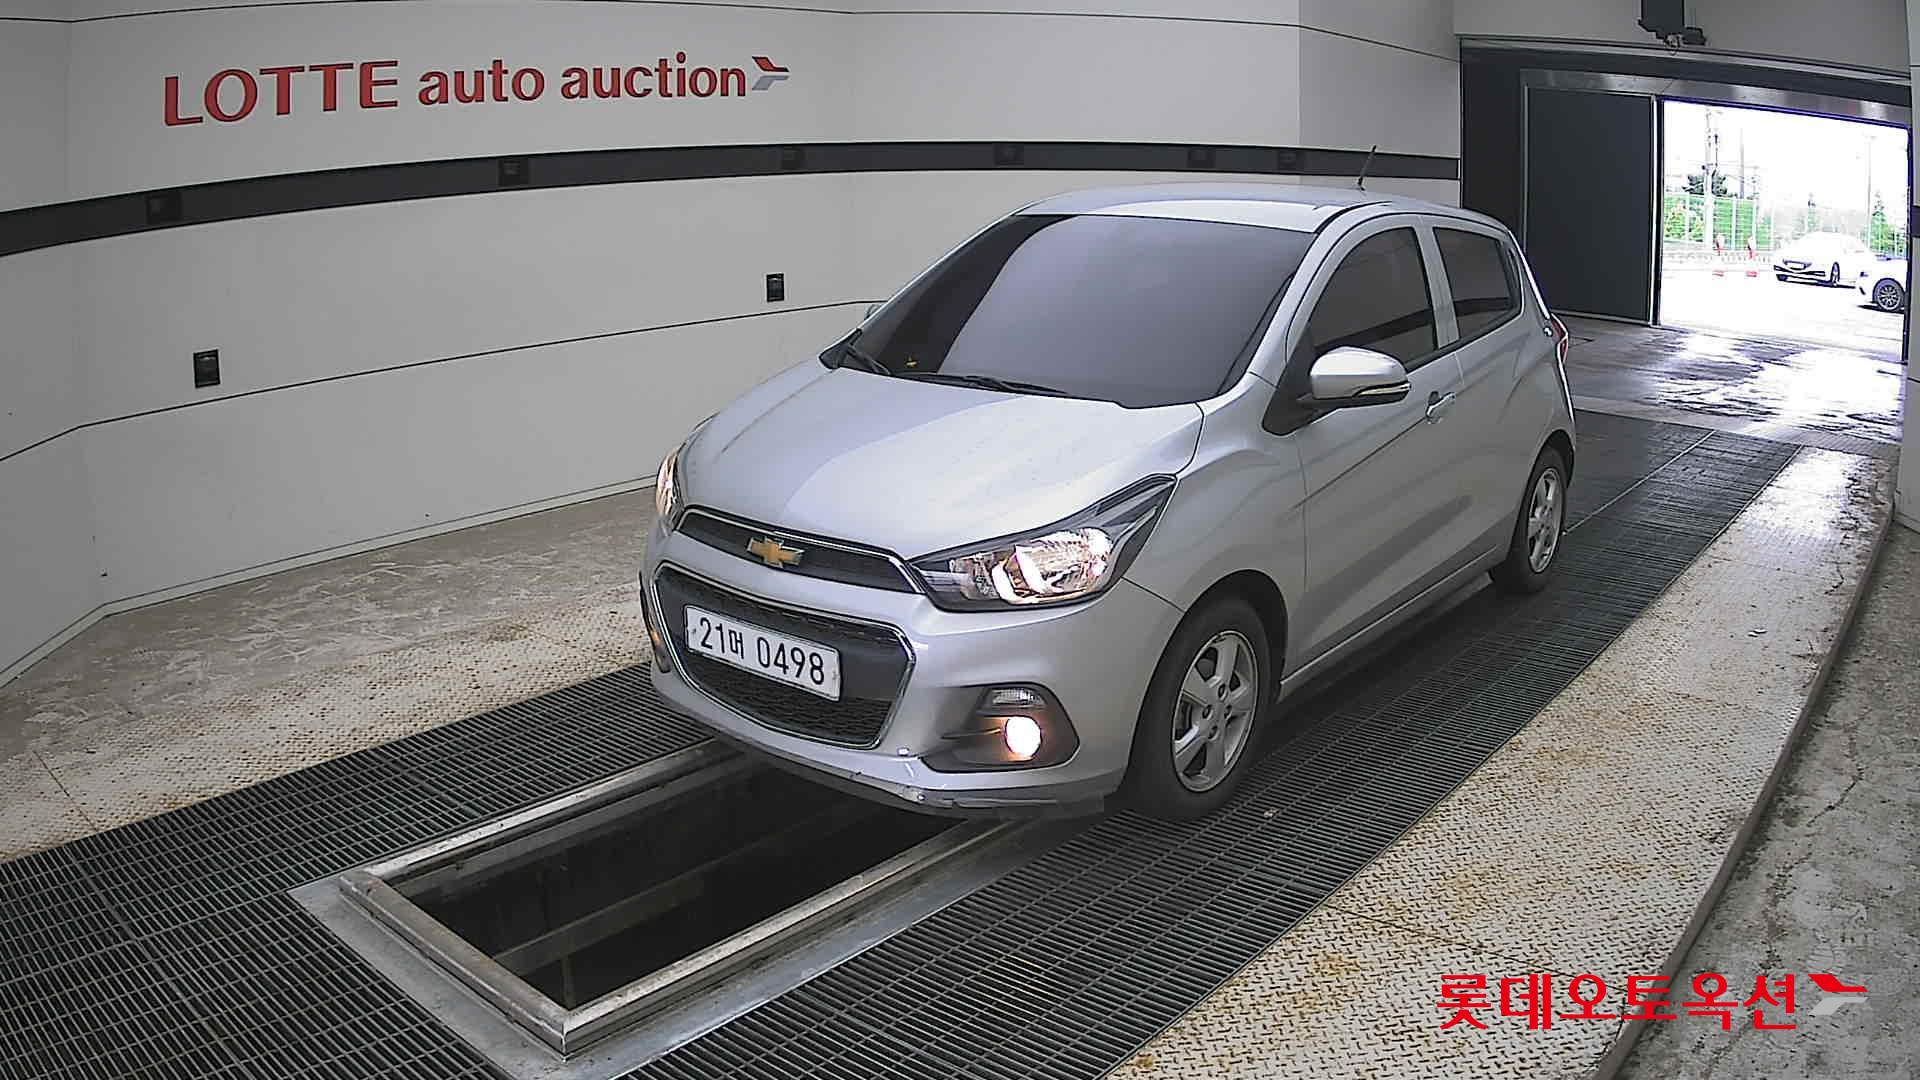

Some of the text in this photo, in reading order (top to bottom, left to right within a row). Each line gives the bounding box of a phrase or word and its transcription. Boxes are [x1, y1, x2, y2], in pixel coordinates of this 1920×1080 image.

[164, 51, 747, 127] LOTTE auto auction
[700, 617, 825, 686] 21머 0498
